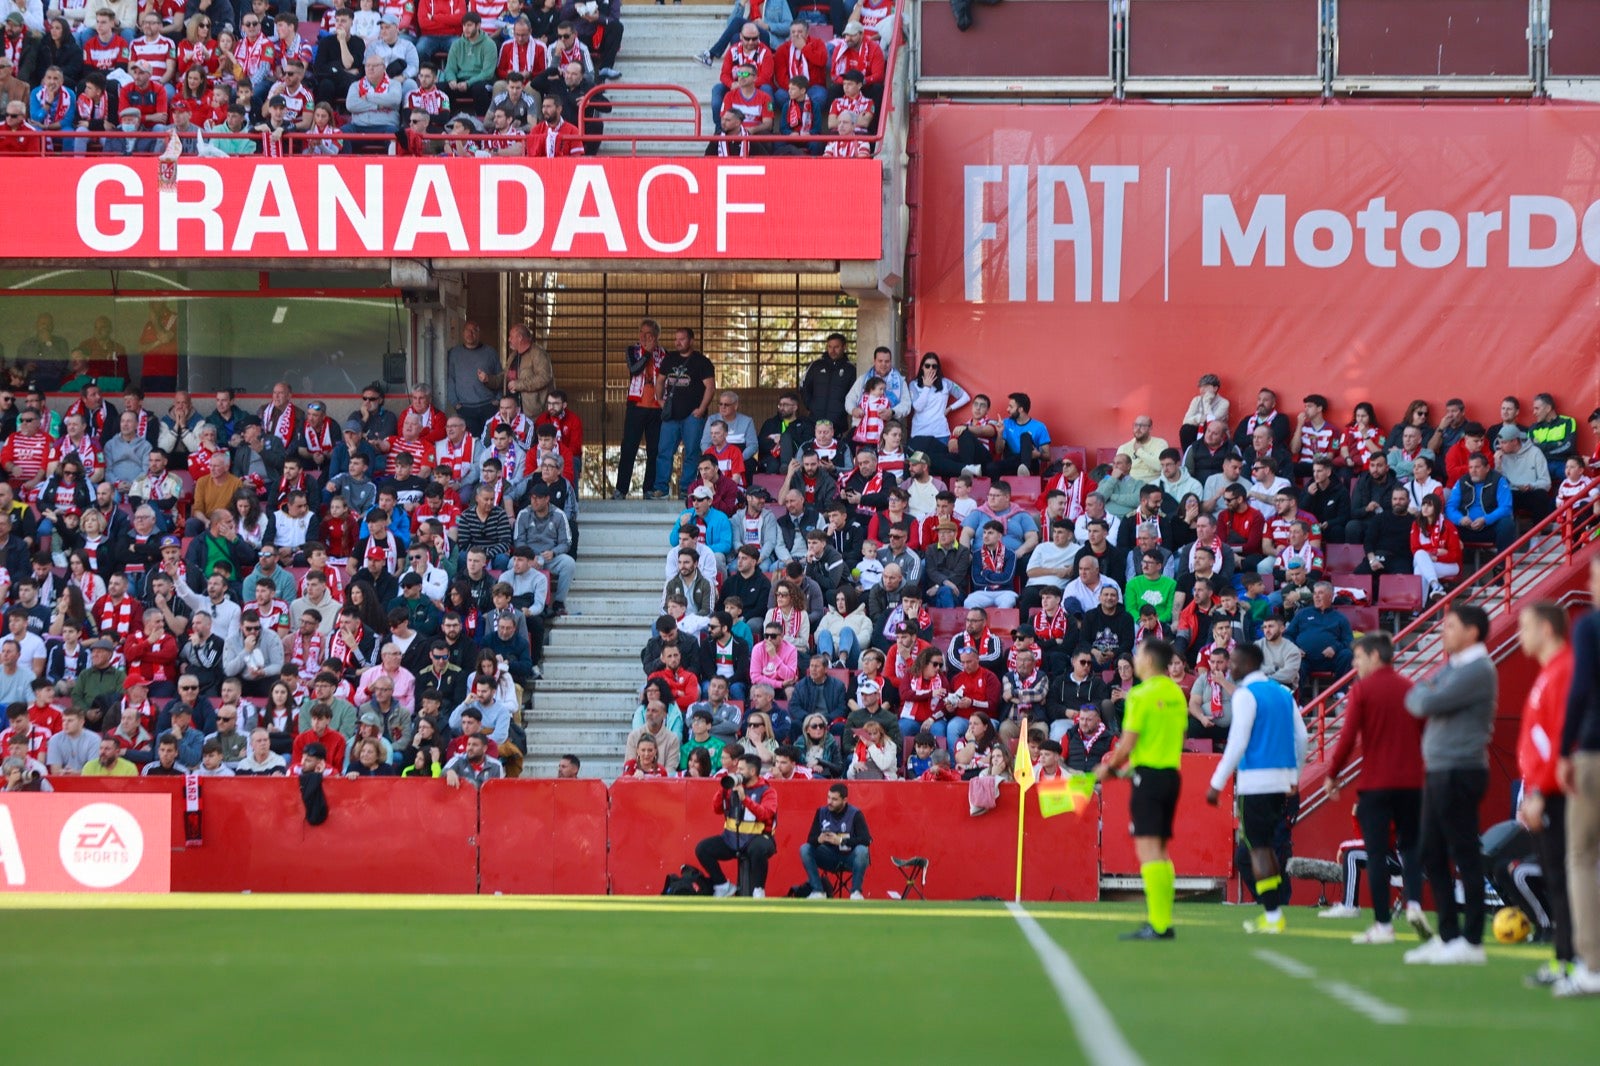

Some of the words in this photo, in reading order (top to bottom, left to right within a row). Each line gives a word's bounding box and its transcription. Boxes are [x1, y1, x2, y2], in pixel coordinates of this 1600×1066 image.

[963, 164, 1140, 303] FIAT
[76, 823, 126, 849] EA
[73, 851, 129, 864] SPORTS
